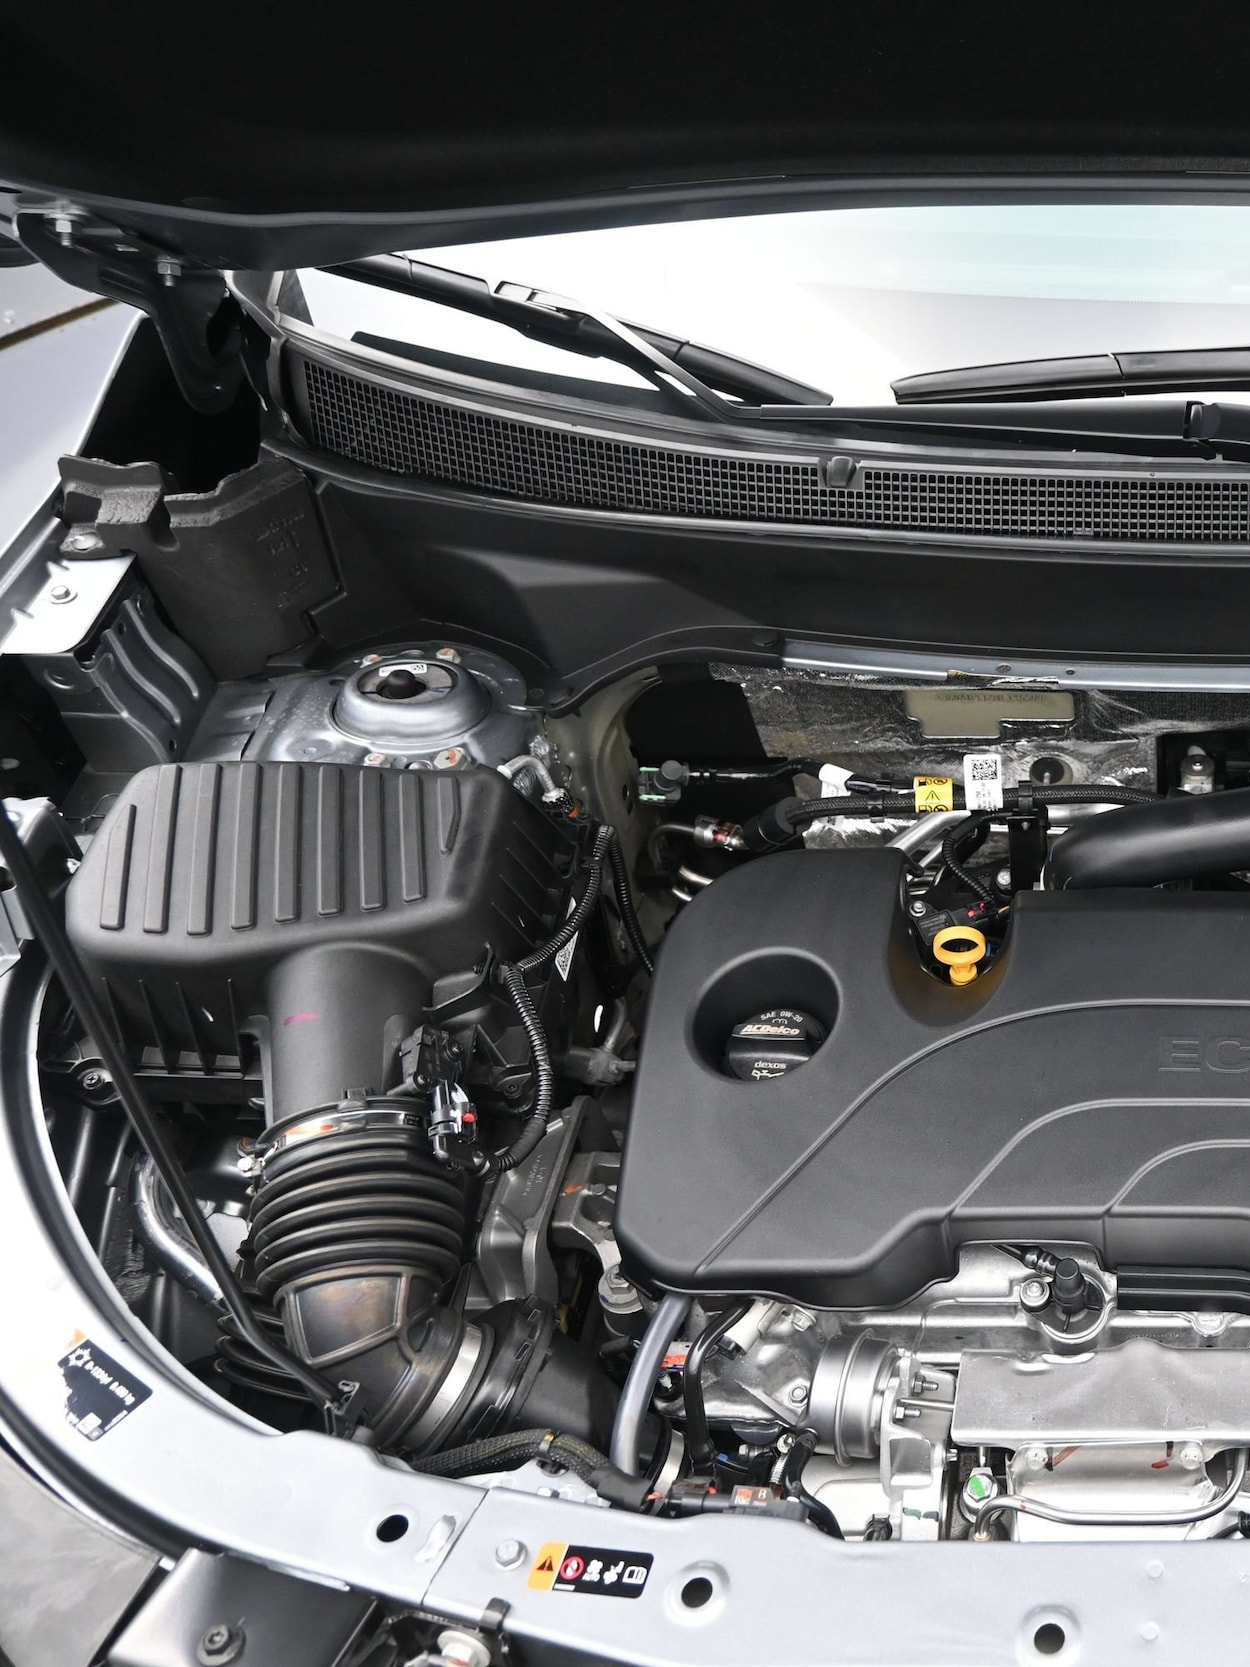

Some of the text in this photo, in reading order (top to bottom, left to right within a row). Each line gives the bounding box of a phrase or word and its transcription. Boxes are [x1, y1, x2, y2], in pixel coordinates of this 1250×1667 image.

[760, 1010, 804, 1023] SAE 0W-20
[740, 1024, 801, 1036] ACDelco
[754, 1060, 787, 1070] dexos
